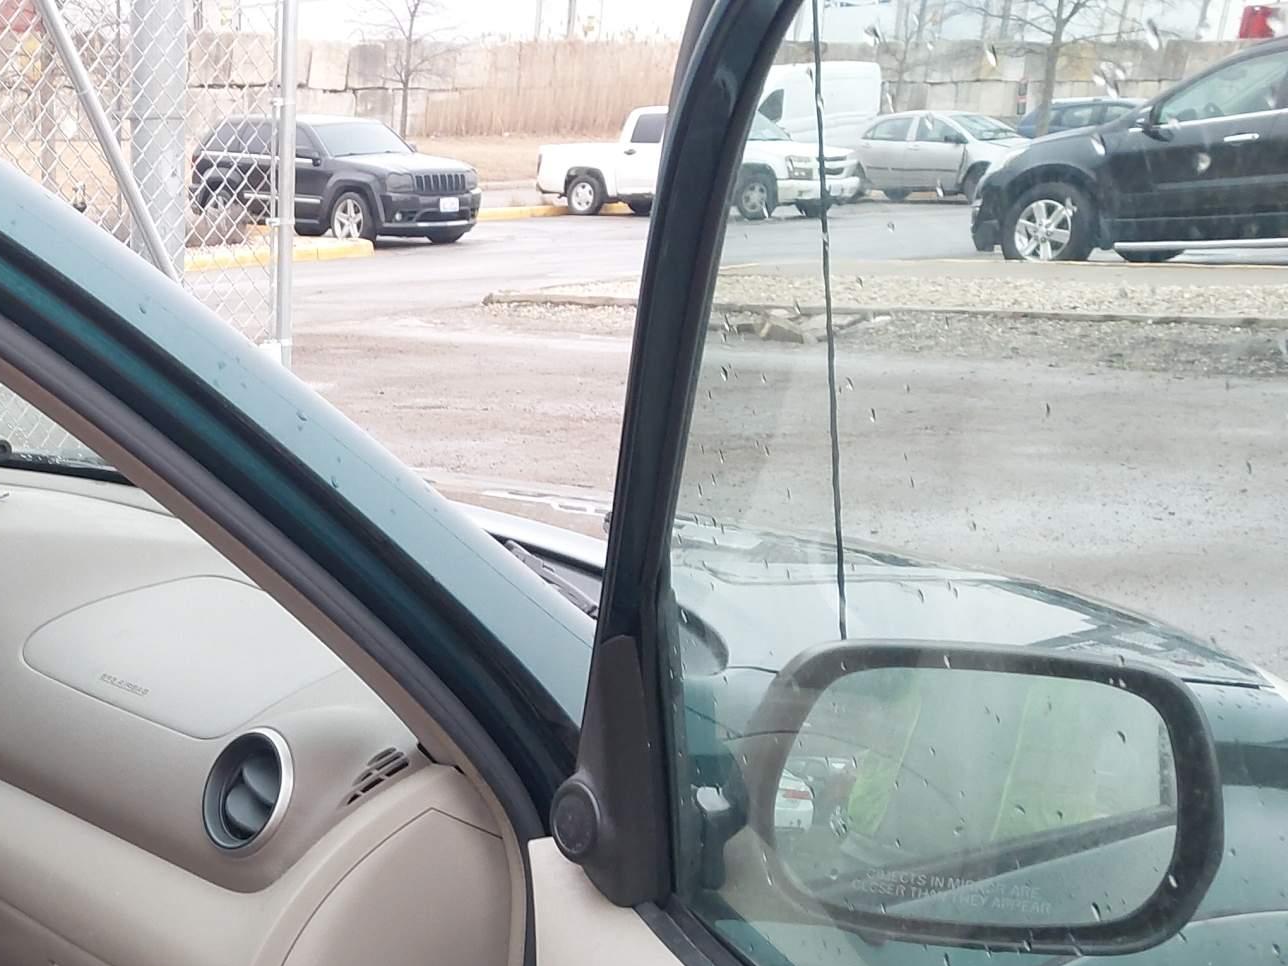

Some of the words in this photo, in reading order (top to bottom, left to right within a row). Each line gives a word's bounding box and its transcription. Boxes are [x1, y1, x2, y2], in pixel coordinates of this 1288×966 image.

[852, 880, 905, 898] CLOSER
[950, 893, 986, 907] THEY
[992, 897, 1052, 914] APPEAR
[866, 868, 927, 887] OBJECTS
[930, 876, 944, 889] IN
[1011, 884, 1041, 900] ARE
